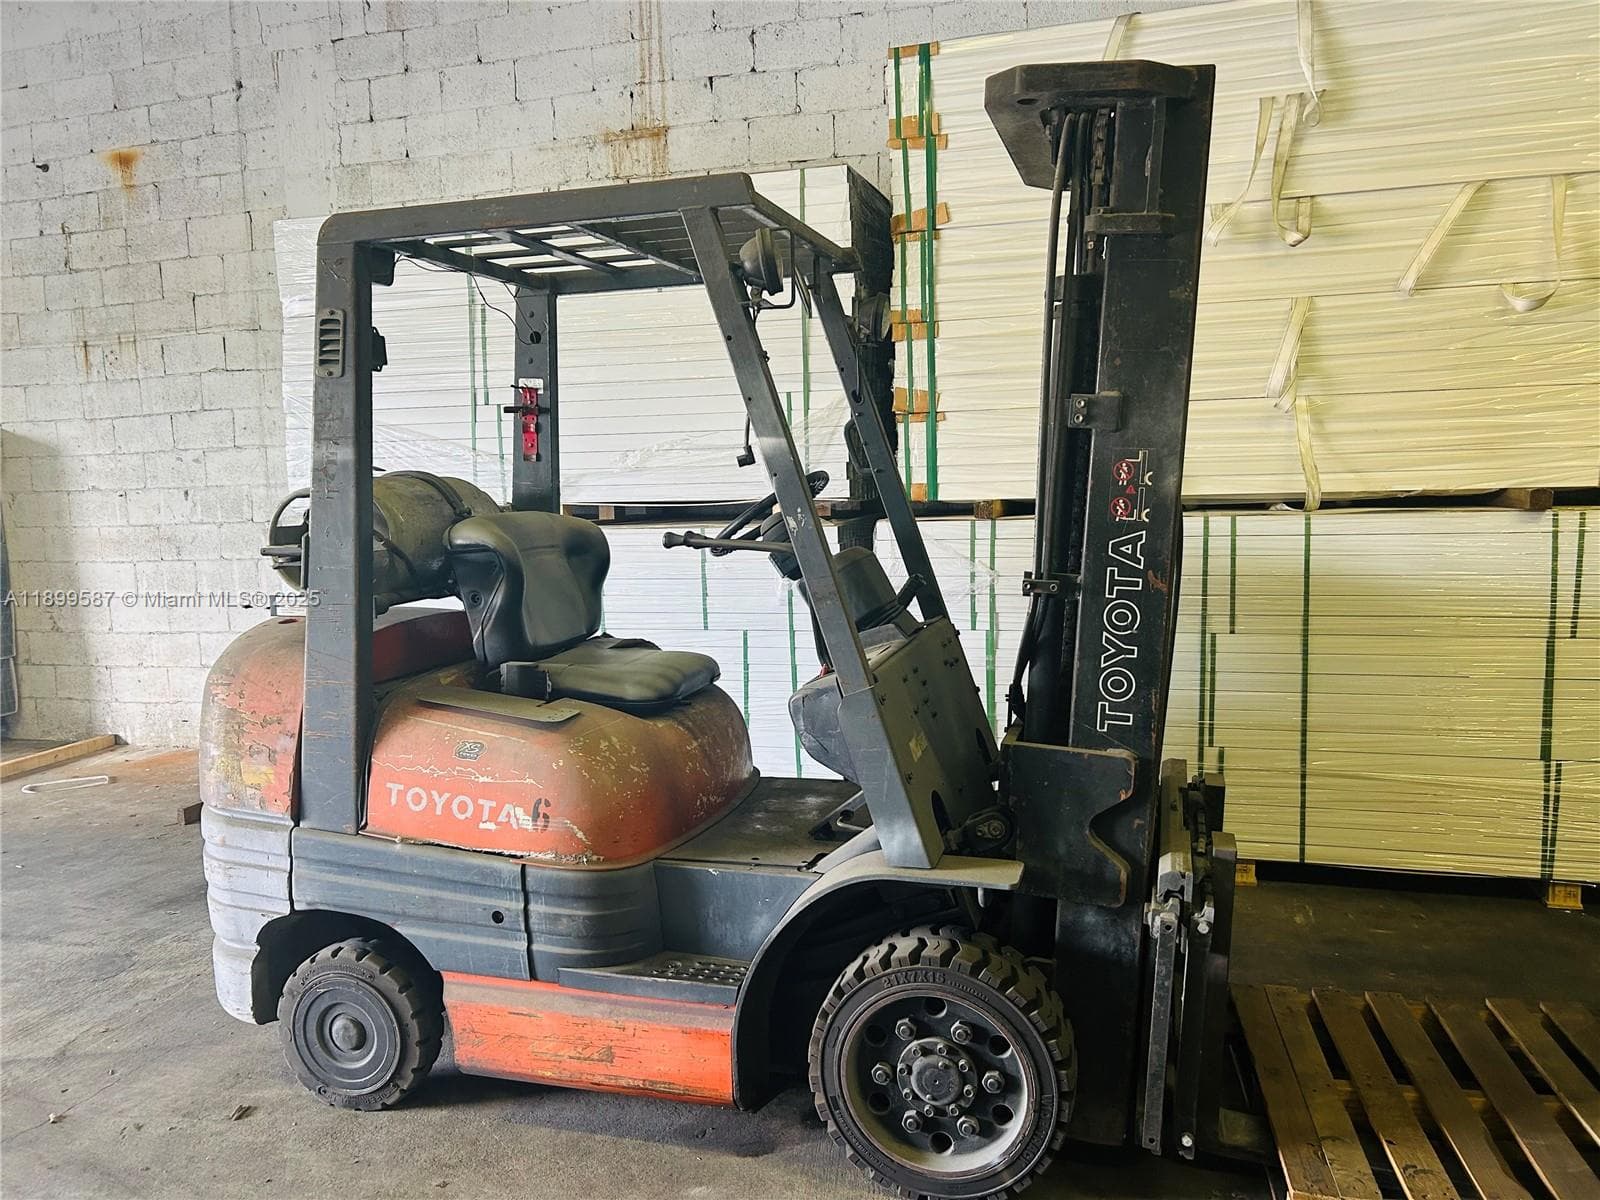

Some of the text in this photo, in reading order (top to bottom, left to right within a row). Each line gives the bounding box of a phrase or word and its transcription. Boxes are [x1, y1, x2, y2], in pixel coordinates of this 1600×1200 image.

[1097, 530, 1146, 732] TOYOTA
[386, 782, 519, 830] TOYOTA
[531, 797, 551, 833] 6
